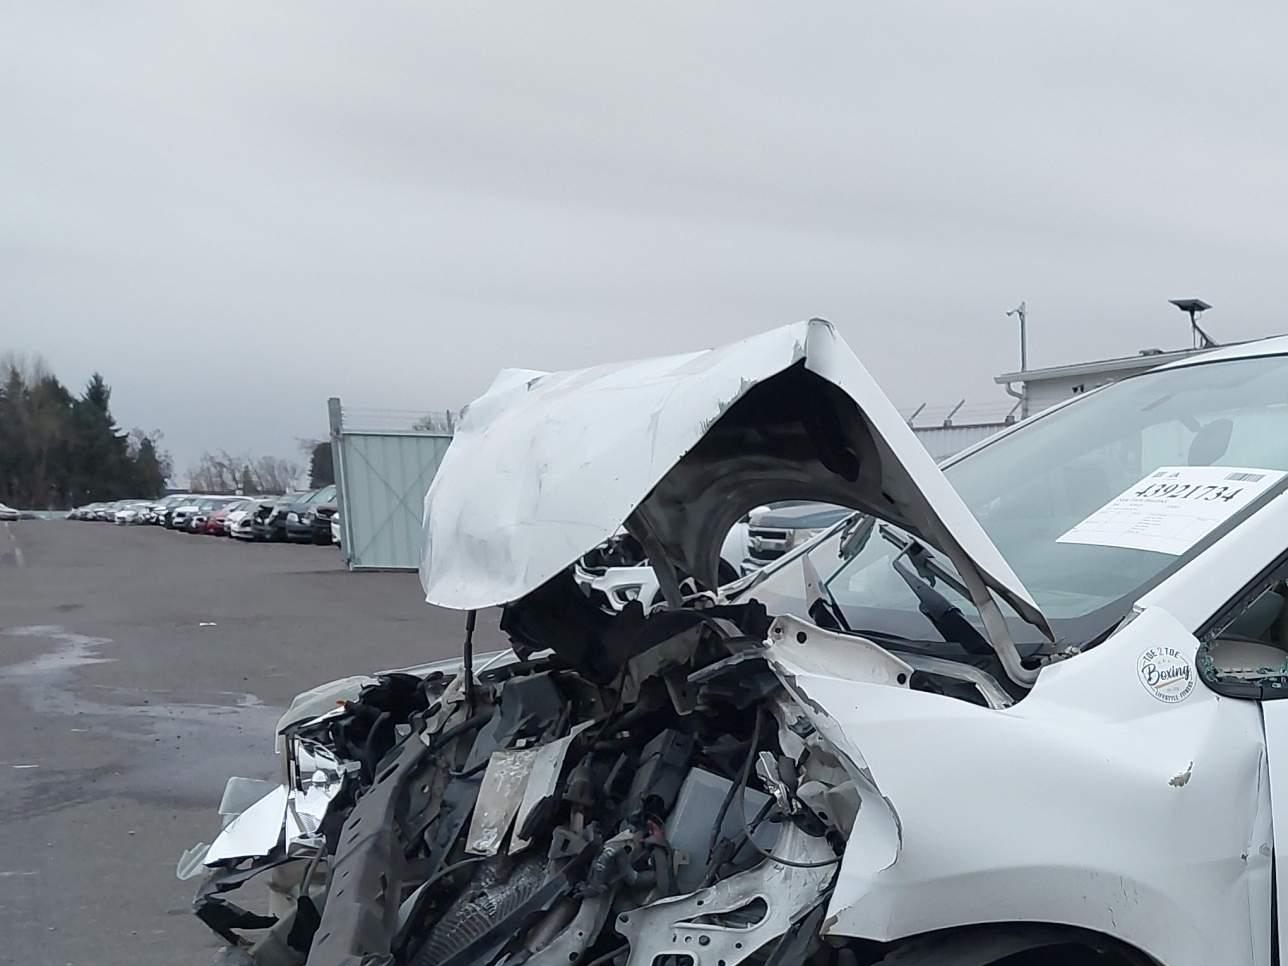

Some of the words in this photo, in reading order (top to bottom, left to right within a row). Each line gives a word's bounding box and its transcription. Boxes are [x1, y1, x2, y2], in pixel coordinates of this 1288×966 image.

[1136, 484, 1243, 502] 43921734
[1143, 649, 1158, 662] TOE
[1165, 647, 1180, 659] TOE
[1141, 663, 1189, 686] Boxing
